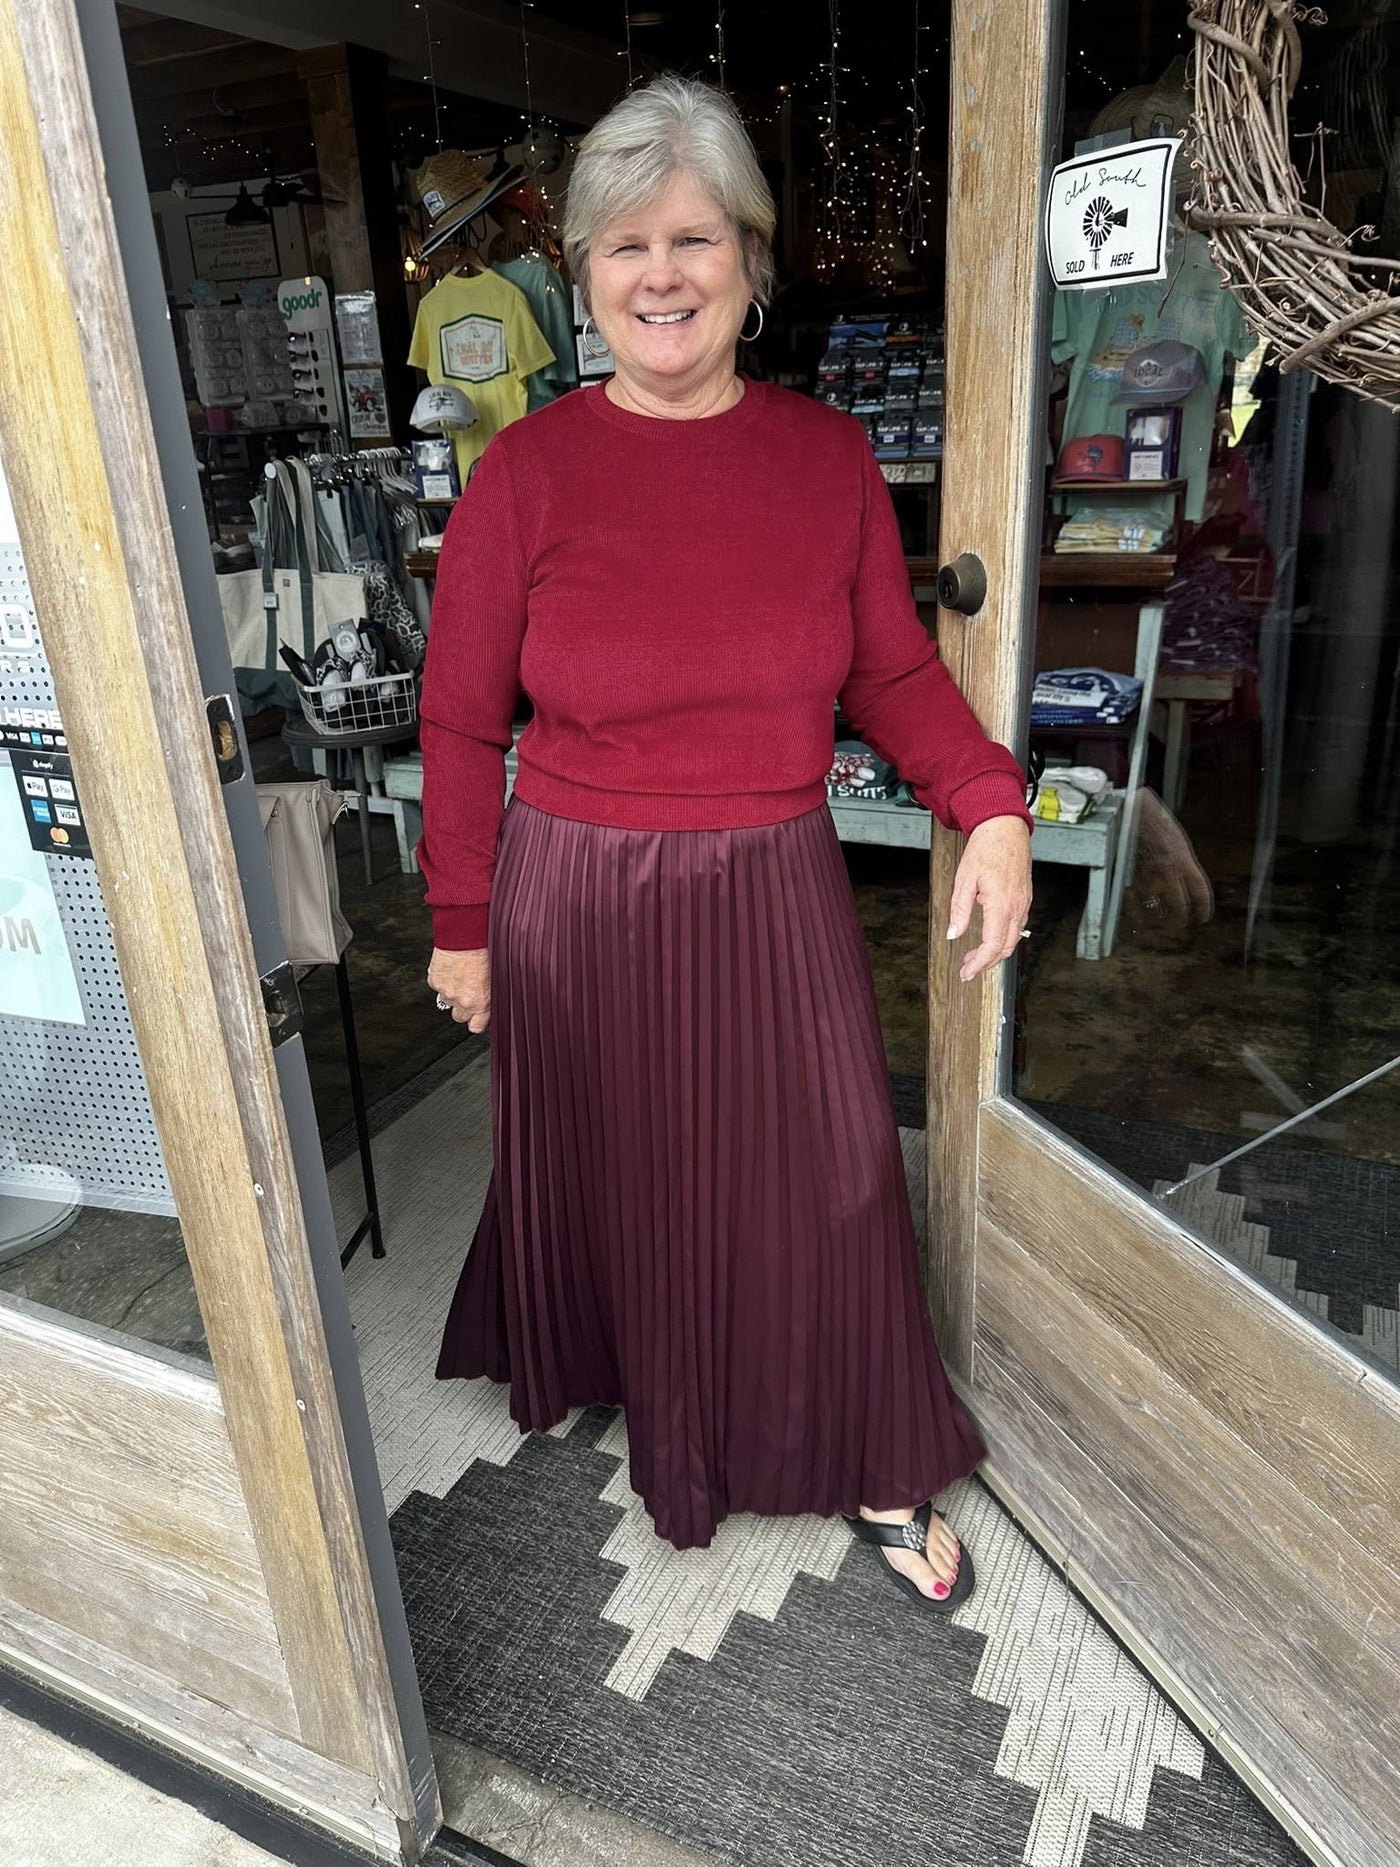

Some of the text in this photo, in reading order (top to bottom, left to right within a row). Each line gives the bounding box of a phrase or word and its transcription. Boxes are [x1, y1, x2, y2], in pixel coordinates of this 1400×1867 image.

[1064, 167, 1147, 205] Old South
[1066, 252, 1134, 274] SOLD HERE
[281, 288, 322, 320] goodr
[1133, 367, 1163, 378] LOCAL
[3, 706, 63, 730] HERE
[32, 782, 44, 793] Pay
[60, 810, 77, 820] VISA
